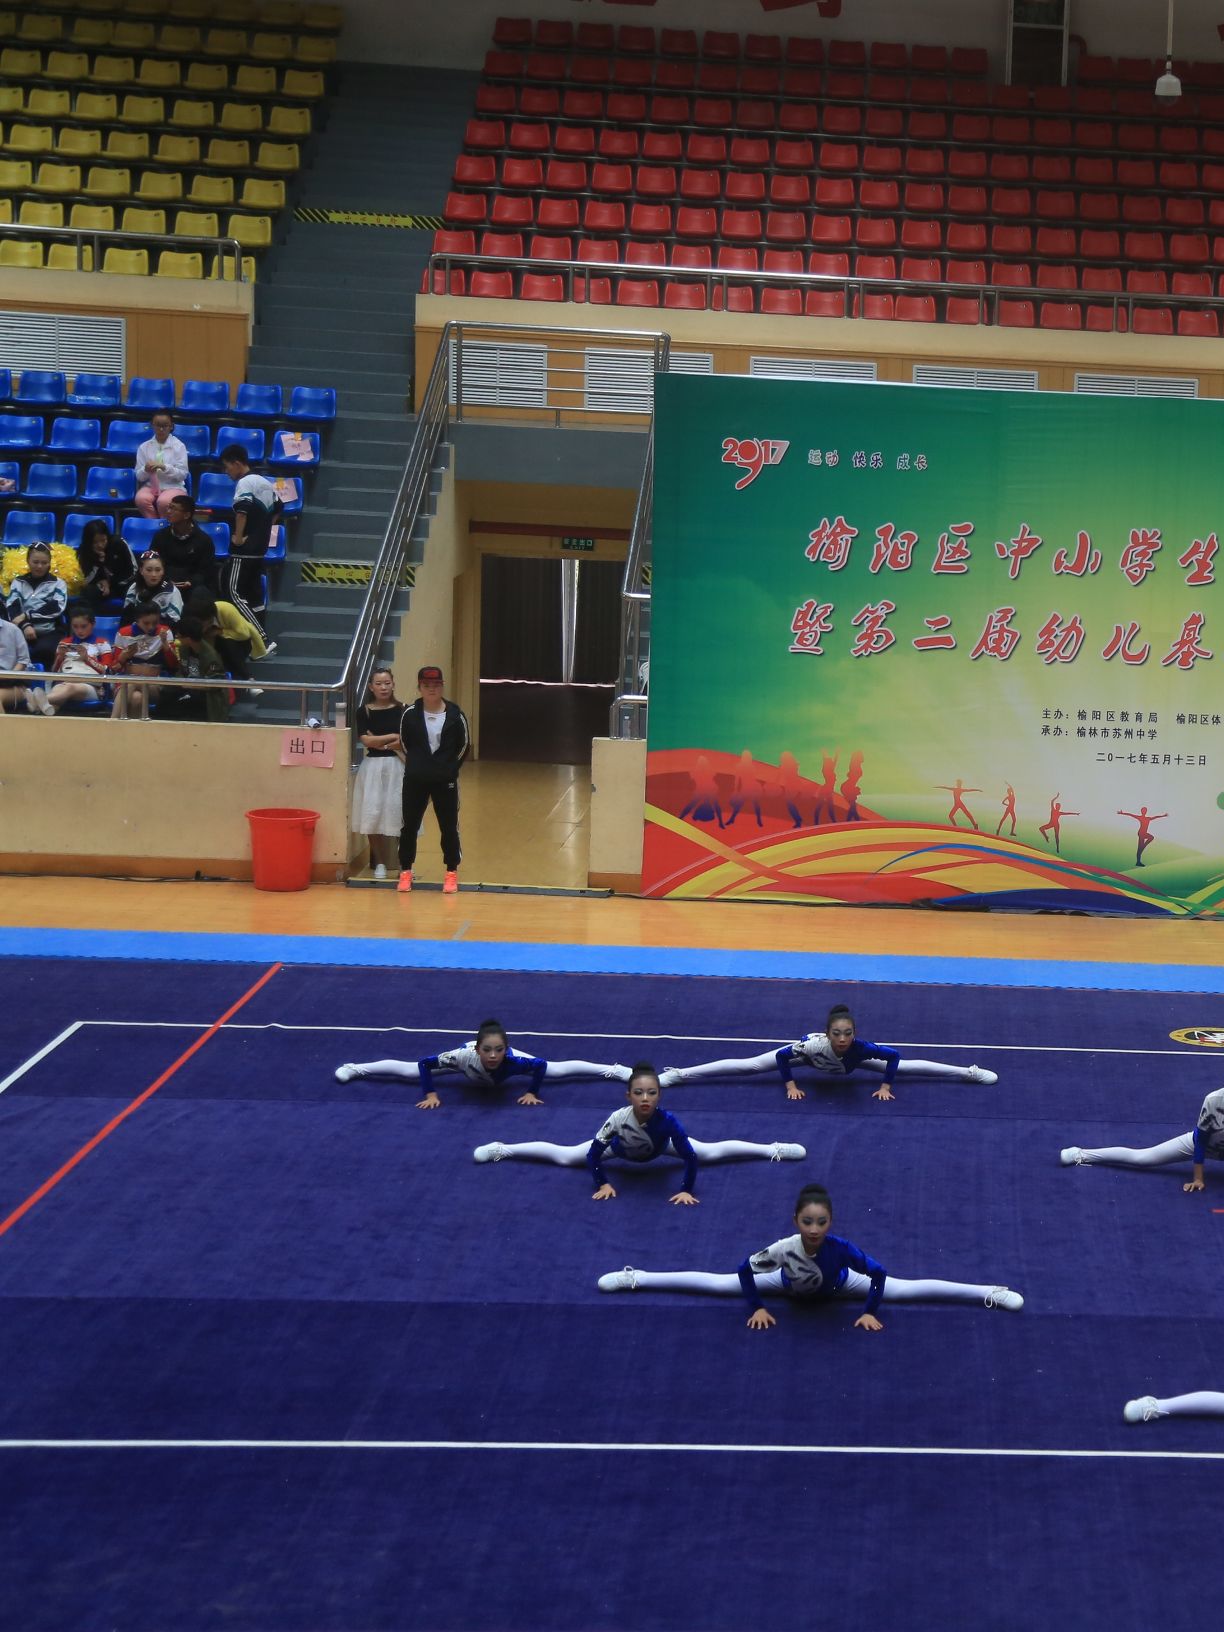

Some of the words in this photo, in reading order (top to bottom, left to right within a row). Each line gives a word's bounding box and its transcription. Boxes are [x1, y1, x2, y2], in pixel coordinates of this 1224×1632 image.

[721, 437, 790, 490] 2017
[807, 449, 839, 467] 运动
[852, 451, 884, 469] 快乐
[896, 453, 929, 472] 成长
[290, 738, 325, 755] 出口
